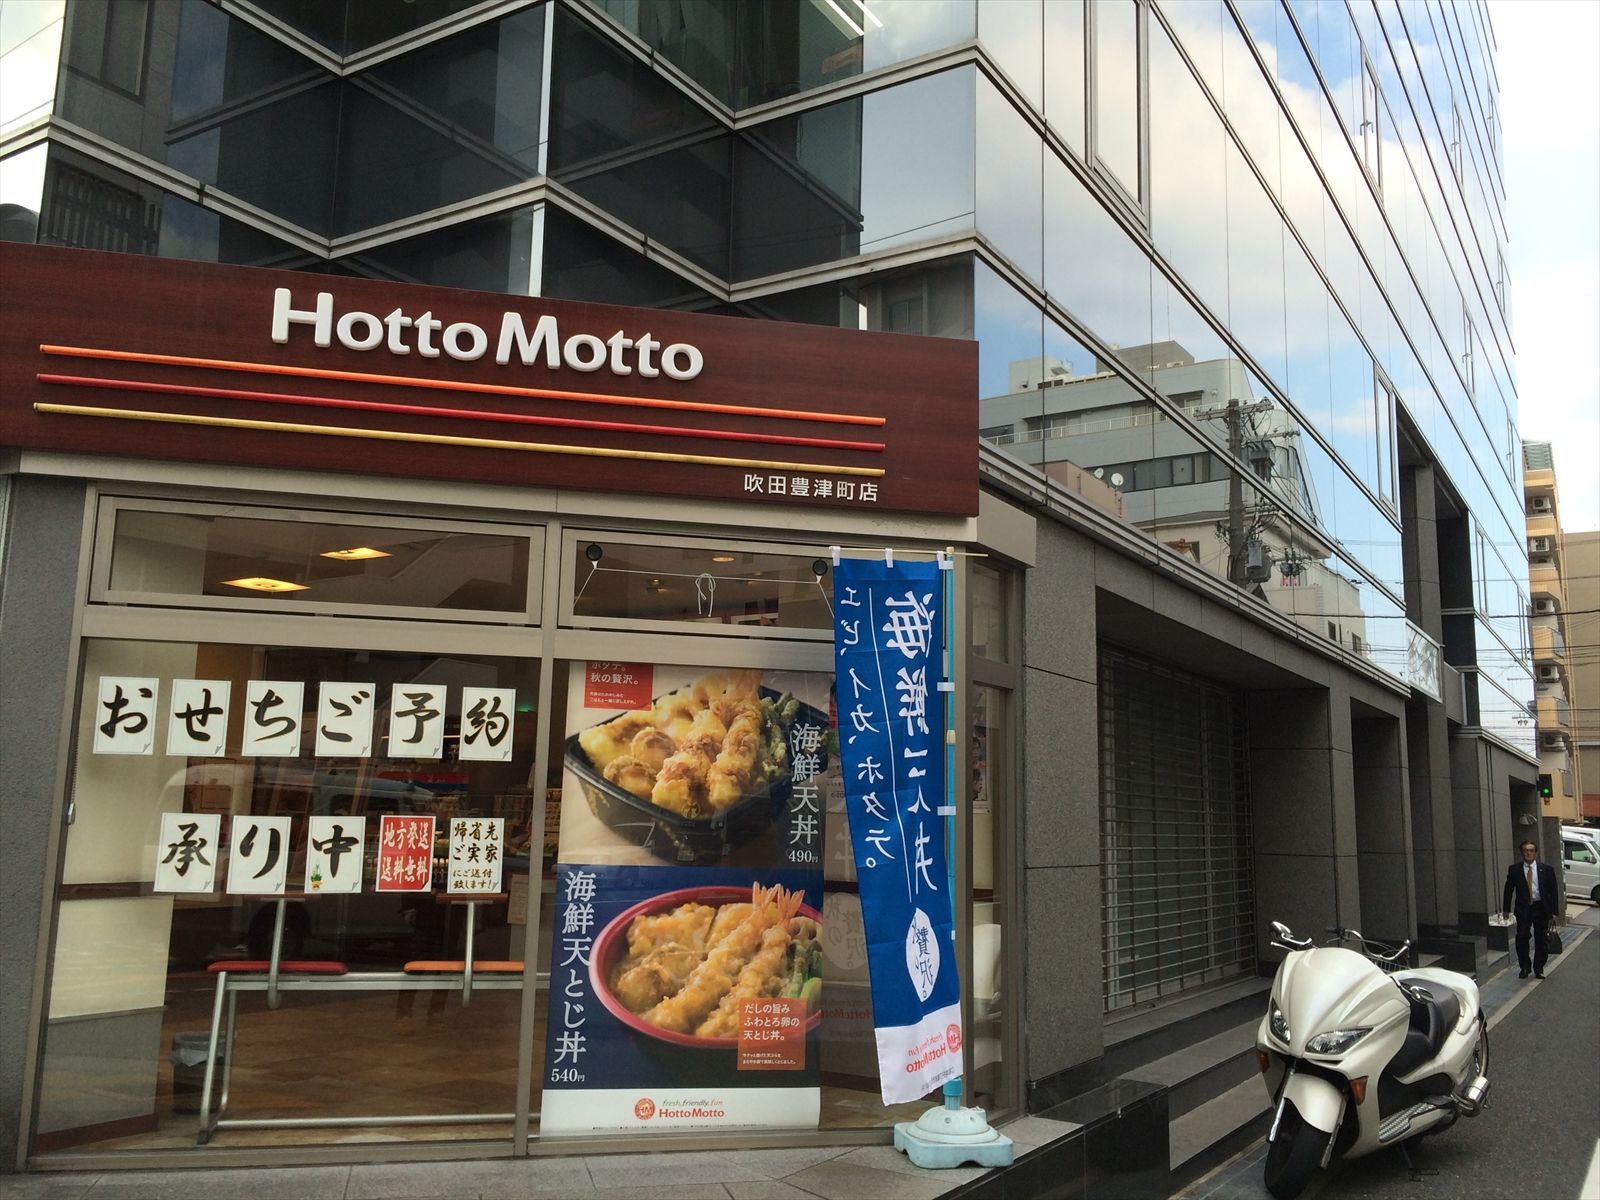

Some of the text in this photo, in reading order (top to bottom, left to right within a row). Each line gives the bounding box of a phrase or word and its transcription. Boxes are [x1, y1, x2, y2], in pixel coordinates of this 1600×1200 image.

[743, 473, 878, 502] 吹田豊津町店
[591, 672, 639, 685] 秋の贅沢。
[99, 684, 510, 747] おせちご予約
[790, 722, 822, 845] 海鮮天丼
[383, 821, 430, 850] 地方発送
[453, 820, 499, 843] 帰省先
[162, 822, 360, 880] 承り中
[452, 843, 498, 864] ご実家
[788, 849, 819, 863] 490円
[381, 855, 428, 885] 送料無料
[452, 868, 493, 879] にご送付
[554, 870, 597, 1064] 海鮮天とじ丼
[744, 1003, 791, 1014] だしの旨み
[743, 1017, 800, 1028] ふわとろ卵の
[743, 1030, 785, 1041] 天とじ丼。
[551, 1068, 586, 1083] 540円
